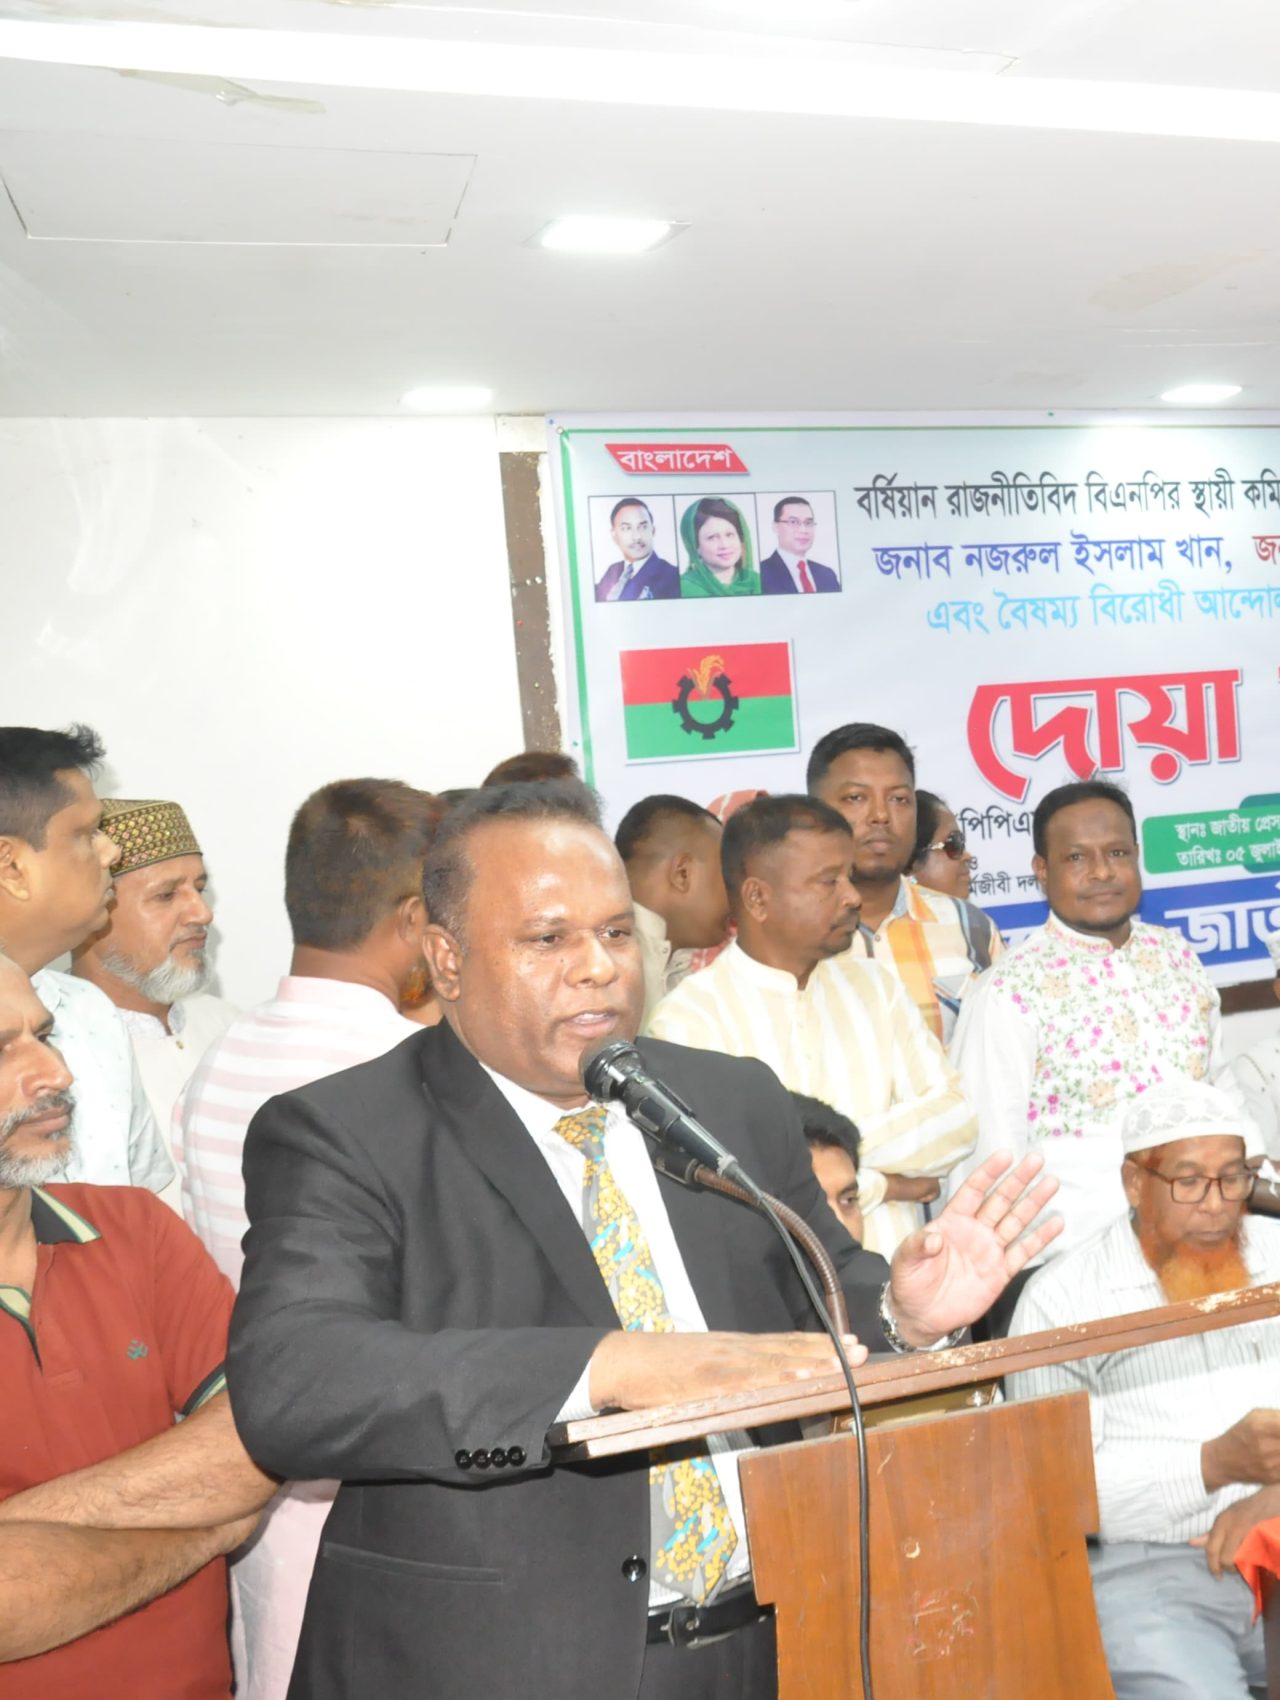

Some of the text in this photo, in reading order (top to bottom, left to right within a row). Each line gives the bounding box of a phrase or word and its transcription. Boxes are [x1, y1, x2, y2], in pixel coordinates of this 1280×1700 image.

[617, 449, 732, 470] বাংলাদেশ
[854, 473, 938, 519] বর্ষিয়ান
[944, 470, 1077, 518] রাজনীতিবিদ
[1085, 470, 1181, 513] বিএনপির
[1188, 467, 1235, 518] স্থায়ী
[871, 542, 952, 580] জনাব
[961, 542, 1062, 576] নজরুল
[1070, 529, 1165, 573] ইসলাম
[1176, 534, 1232, 574] খান,
[927, 600, 990, 634] এবং
[993, 588, 1080, 630] বৈষম্য
[1089, 579, 1184, 626] বিরোধী
[966, 668, 1242, 802] দোয়া
[1209, 813, 1250, 836] জাতীয়
[1226, 847, 1246, 862] ০৫
